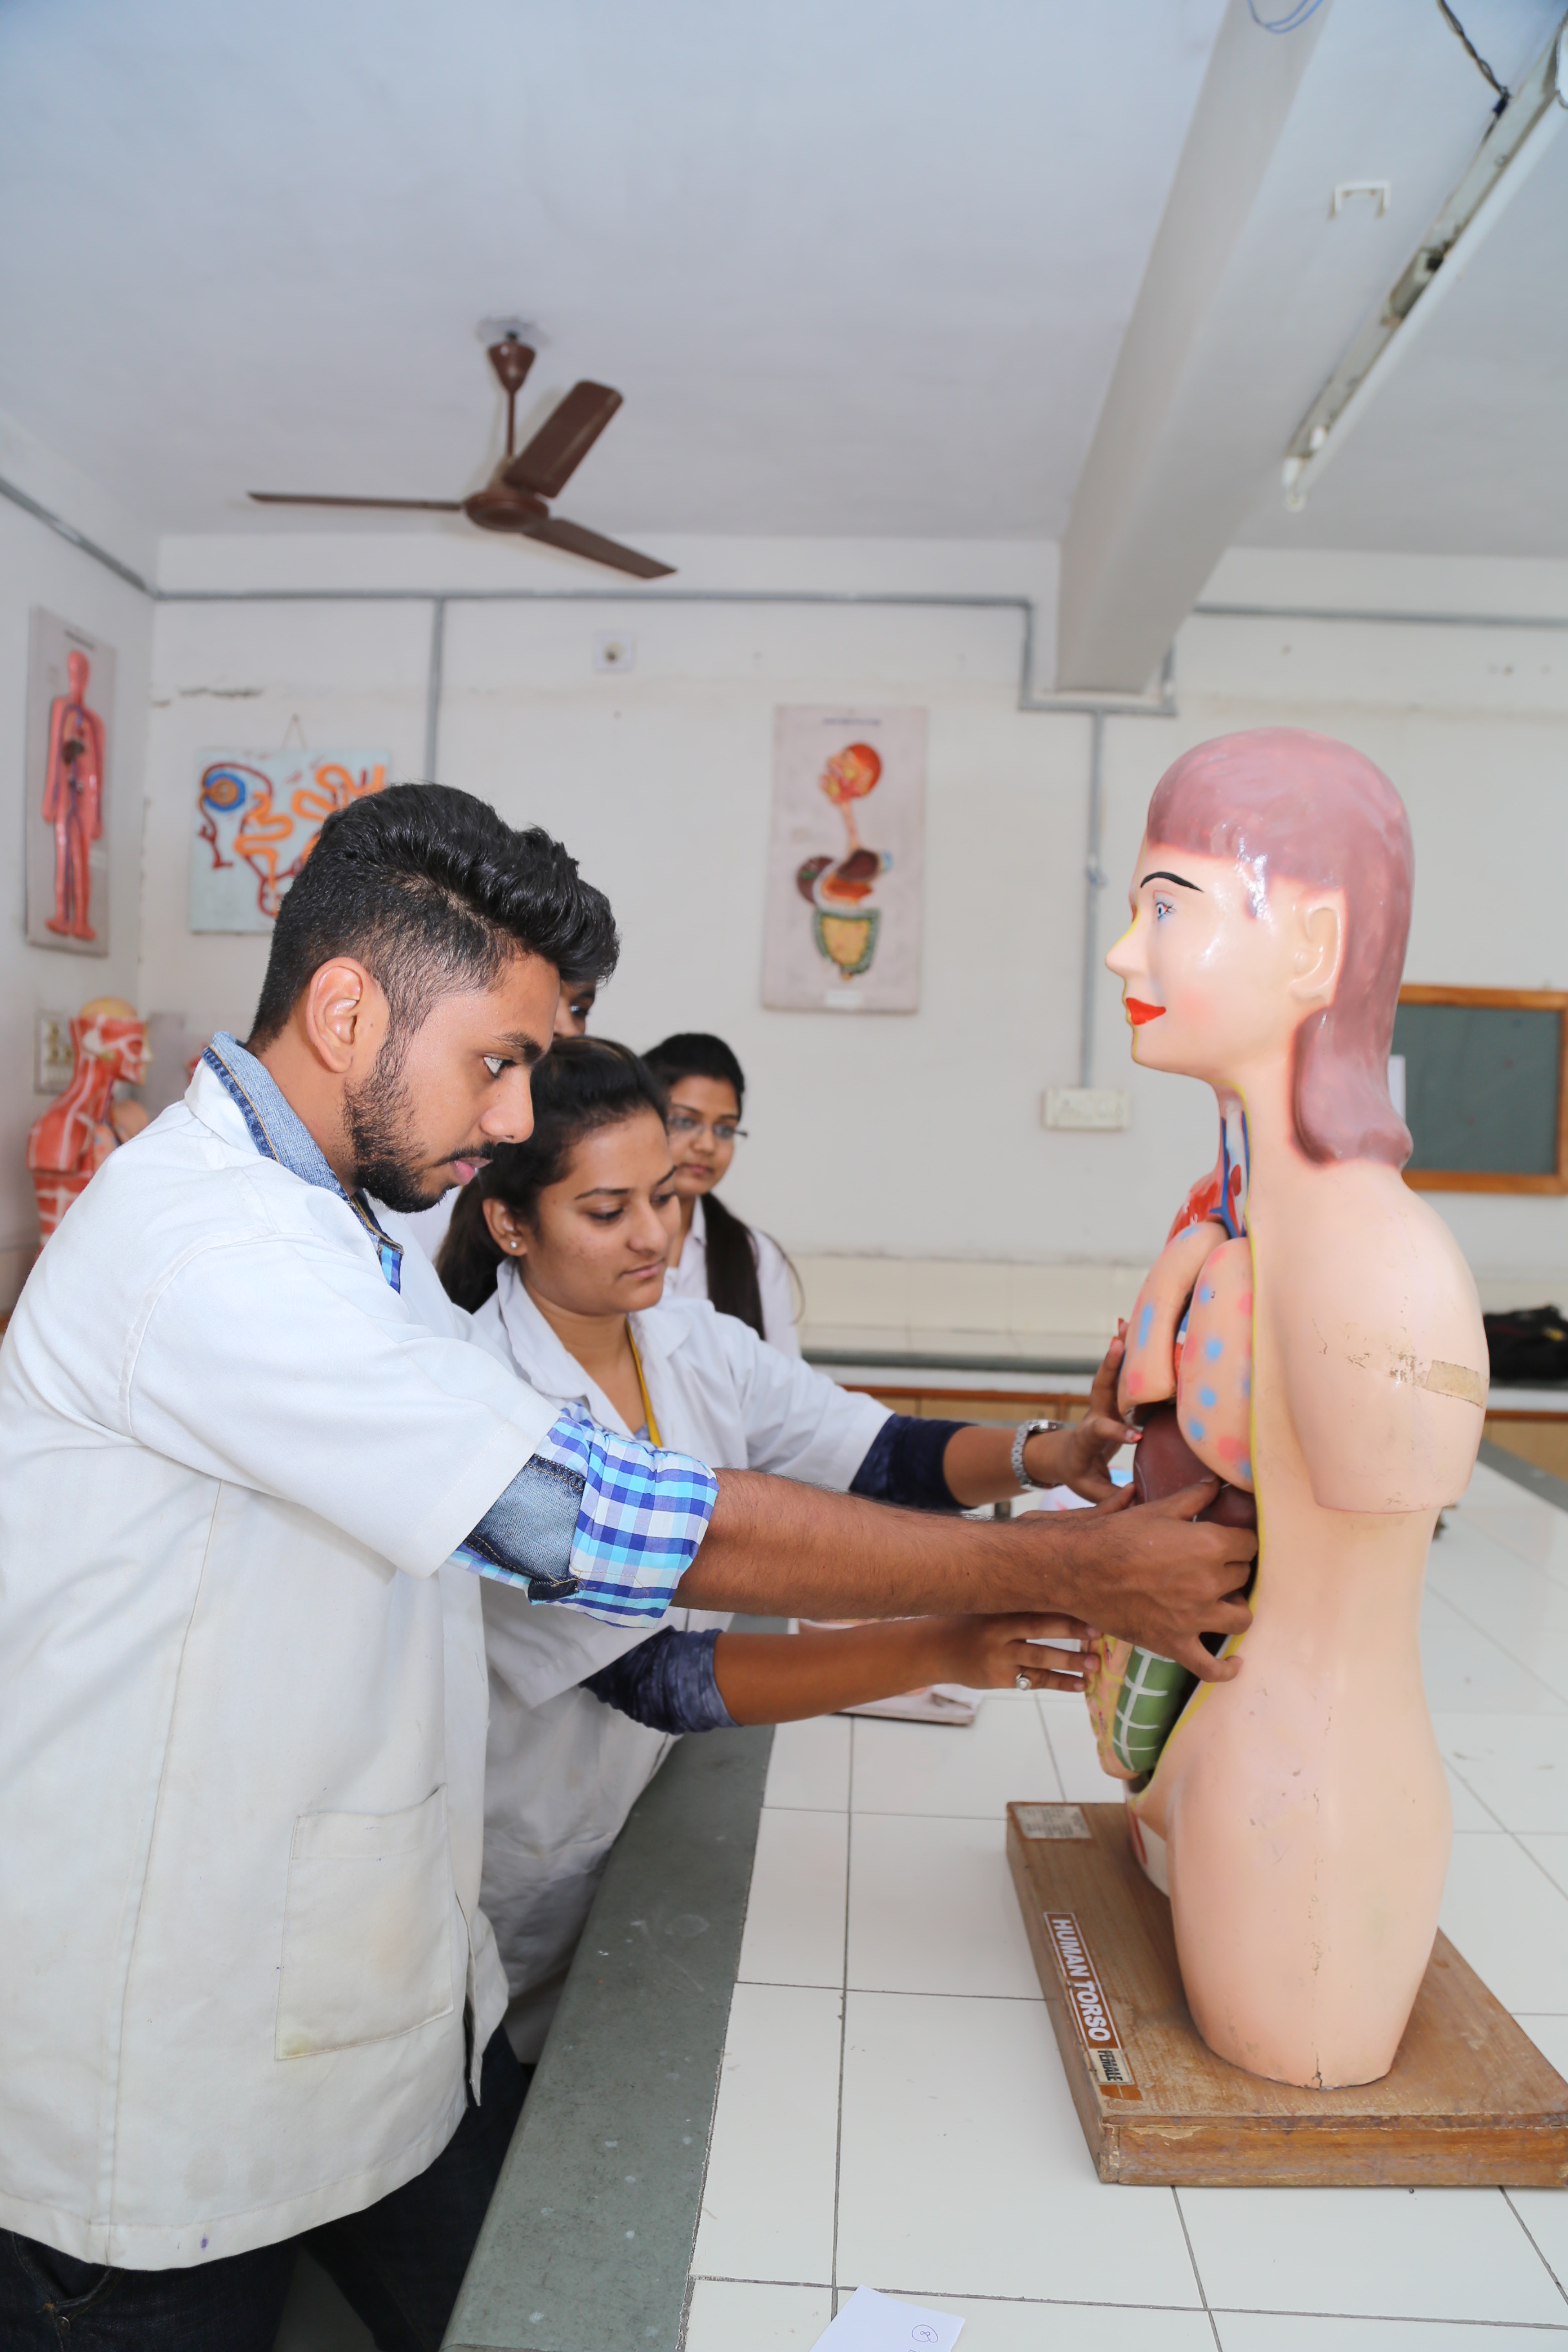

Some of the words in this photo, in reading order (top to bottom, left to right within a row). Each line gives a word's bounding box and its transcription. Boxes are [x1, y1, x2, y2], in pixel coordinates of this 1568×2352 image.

[1052, 1919, 1091, 1977] HUMAN
[1073, 1981, 1112, 2042] TORSO
[1097, 2050, 1123, 2082] FEMALE
